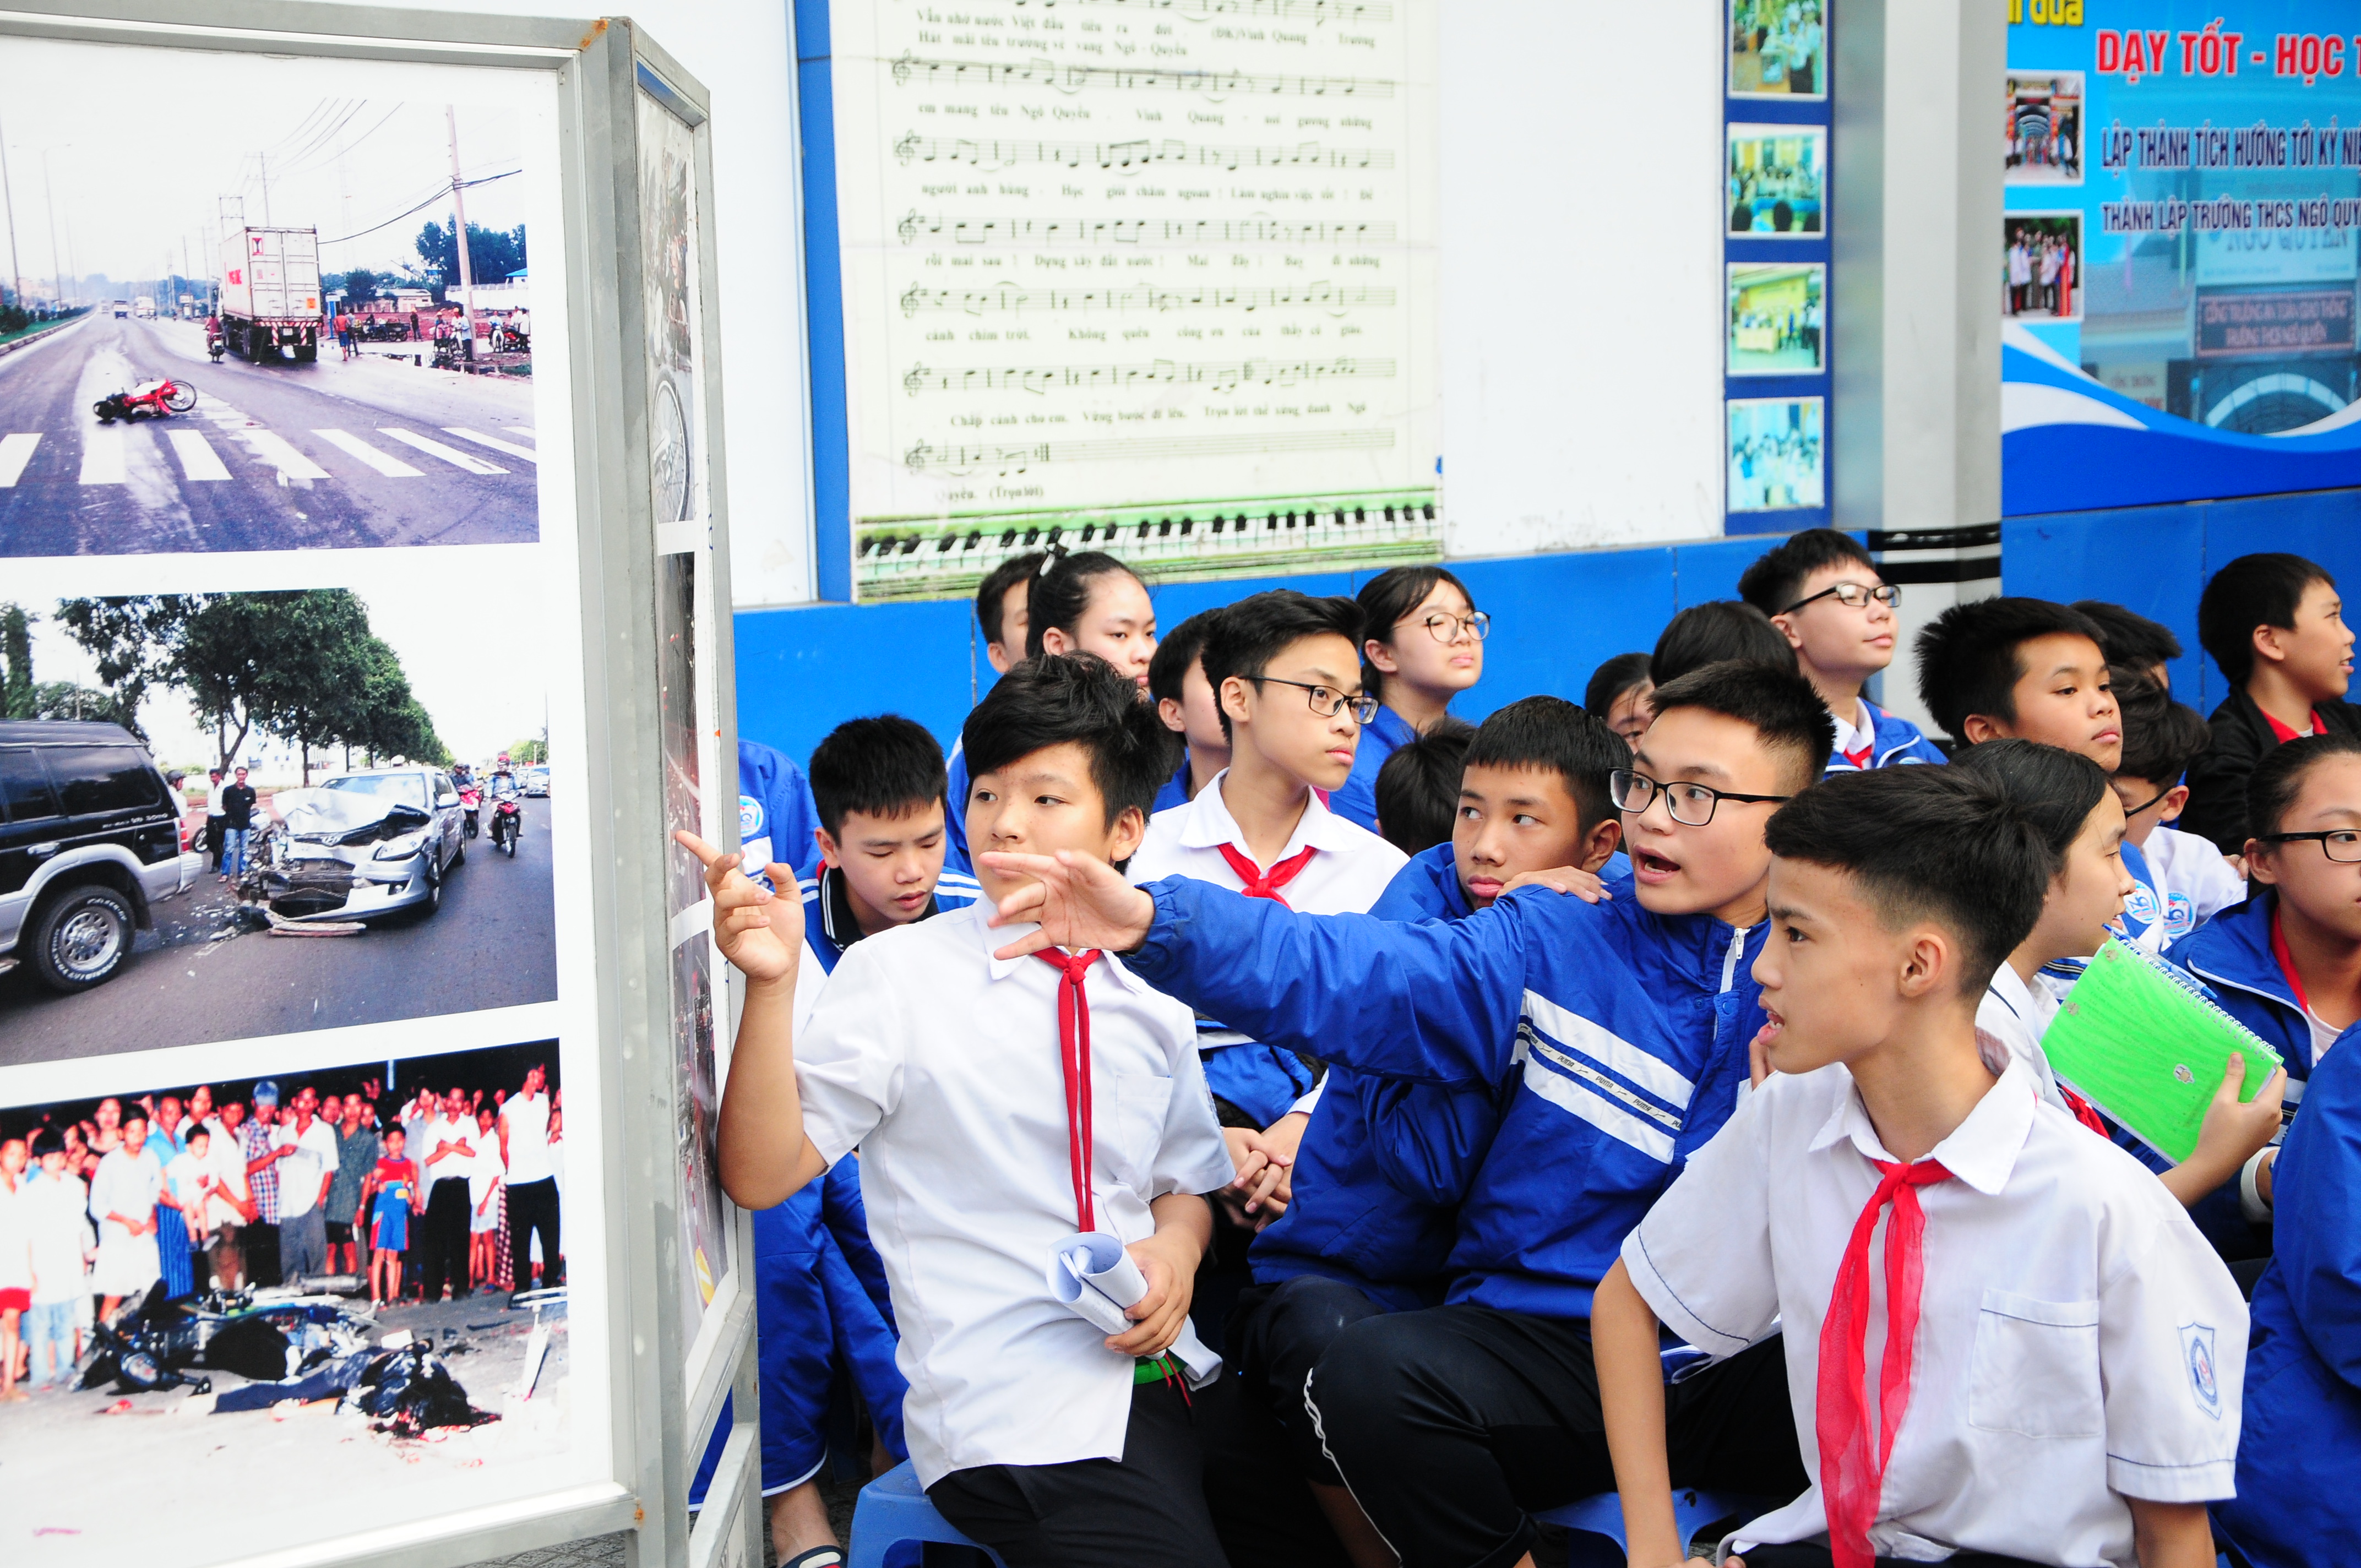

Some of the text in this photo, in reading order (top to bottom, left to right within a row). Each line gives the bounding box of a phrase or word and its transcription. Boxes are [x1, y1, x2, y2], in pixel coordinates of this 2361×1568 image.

[2097, 31, 2168, 83] DẠY
[2179, 18, 2242, 75] TỐT
[2276, 35, 2343, 84] HỌC
[2102, 119, 2132, 177] LẬP
[2138, 119, 2189, 167] THÀNH
[2195, 119, 2229, 167] TÍCH
[2234, 120, 2286, 167] HƯỚNG
[2291, 120, 2314, 167] TỚI
[2102, 195, 2153, 231] THÀNH
[2158, 195, 2187, 239] LẬP
[2193, 194, 2253, 230] TRƯỜNG
[2257, 199, 2293, 228] THCS
[2299, 193, 2329, 228] NGÔ
[1557, 1055, 1575, 1068] PUMA
[1595, 1076, 1614, 1088] PUMA
[1633, 1099, 1652, 1112] PUMA
[1672, 1120, 1683, 1129] PU
